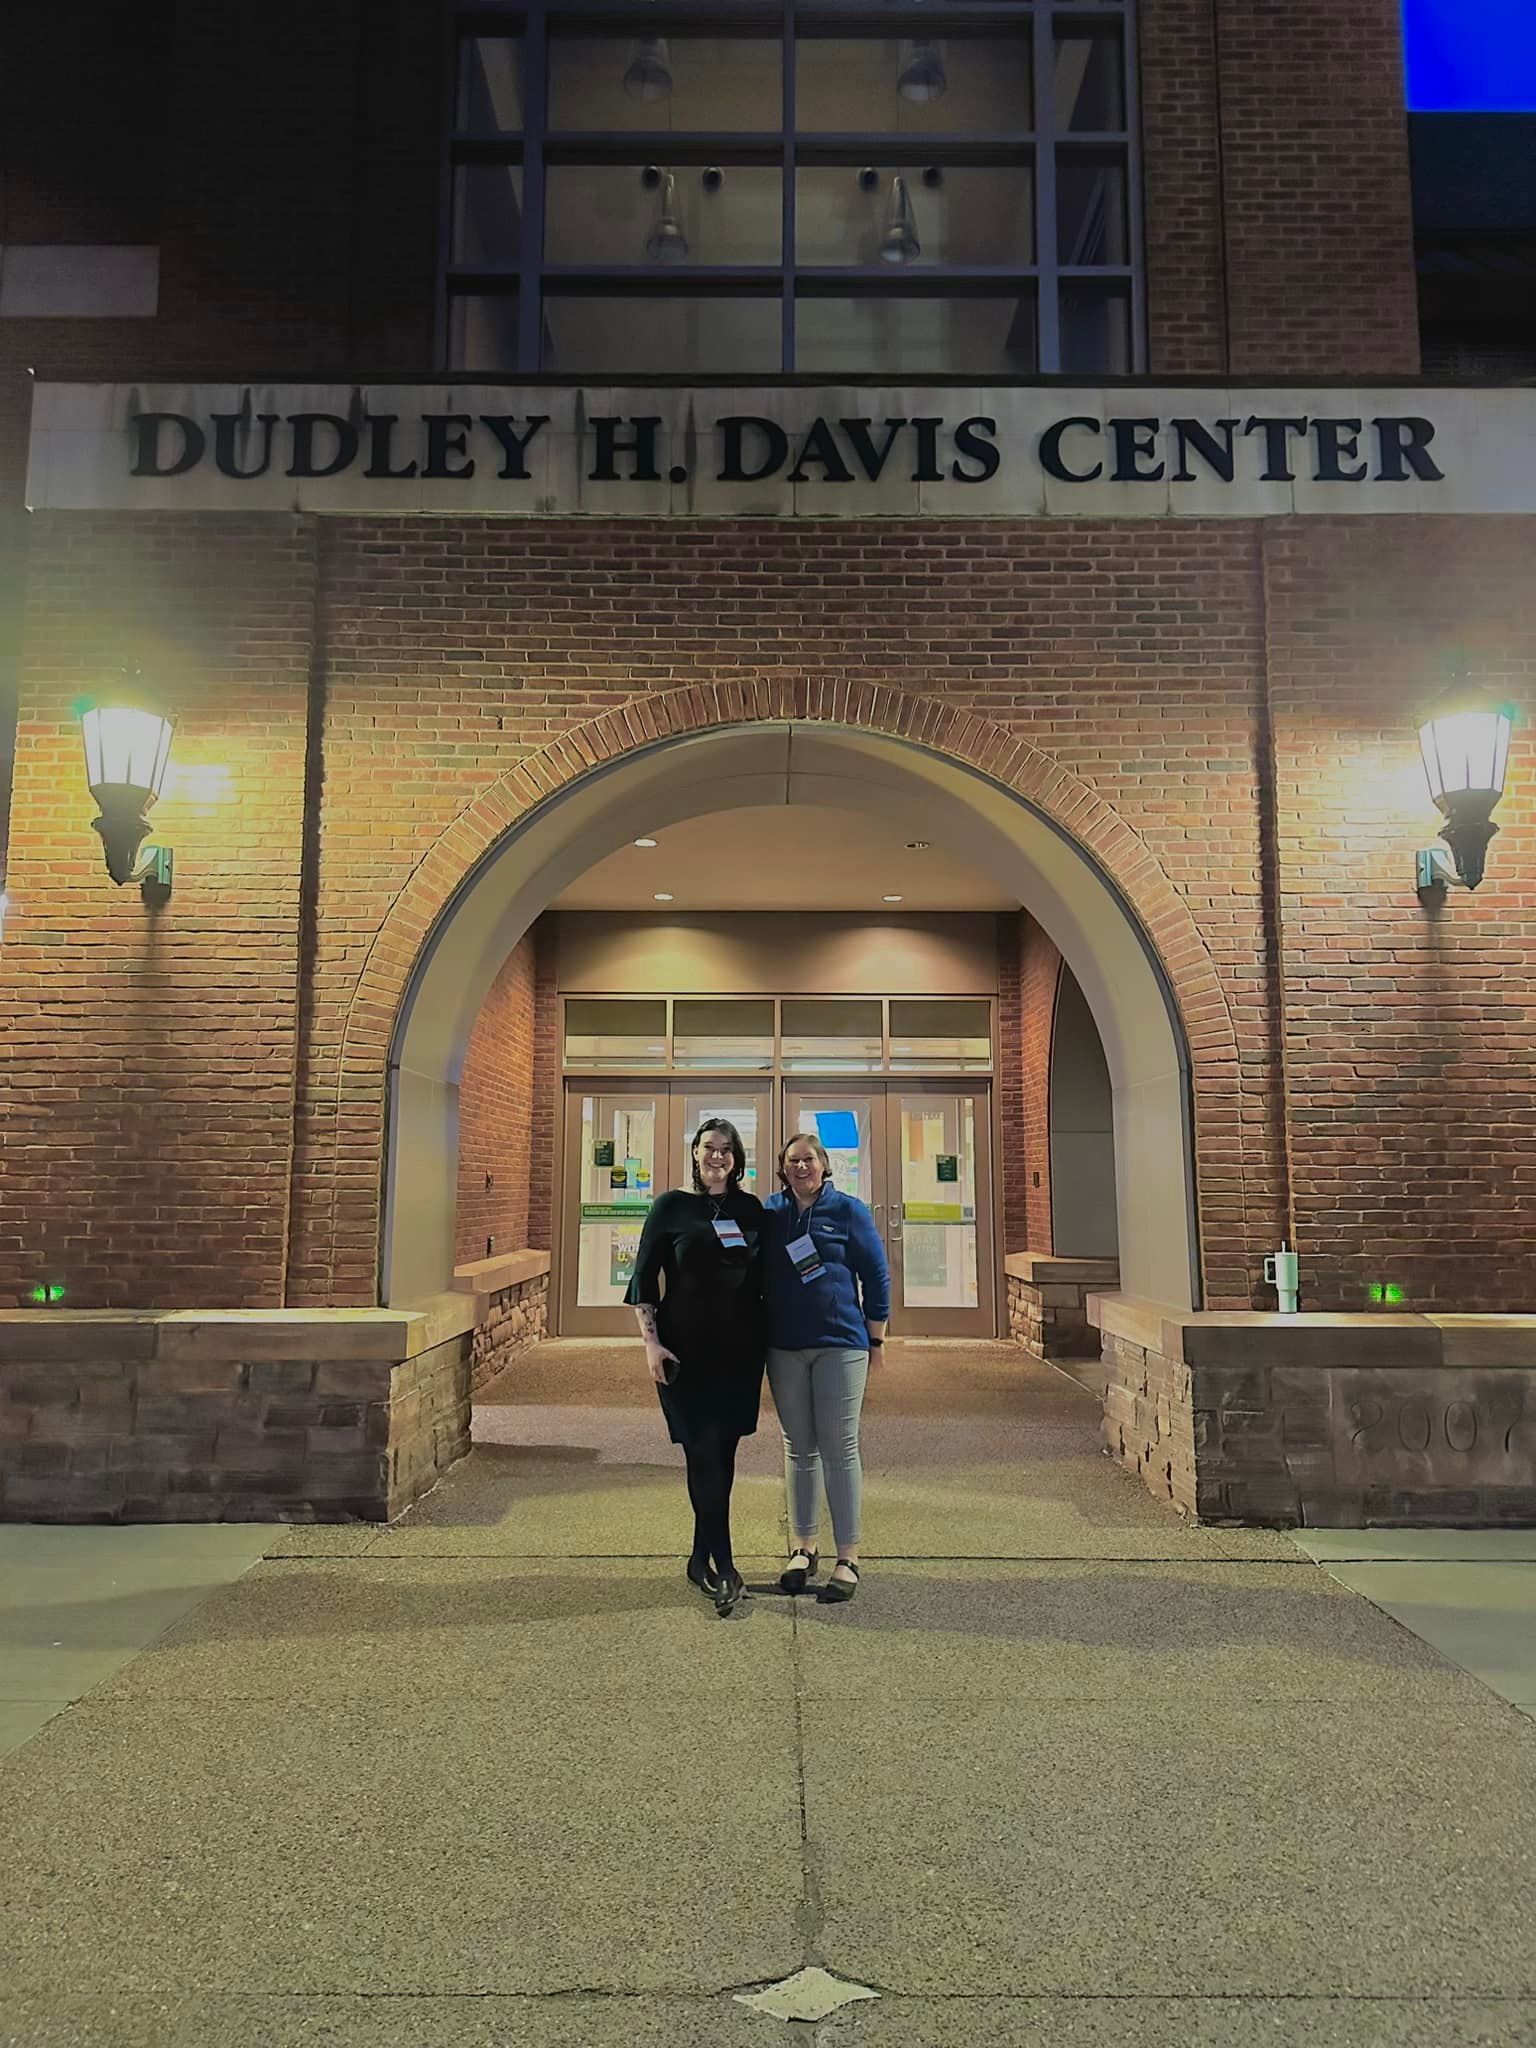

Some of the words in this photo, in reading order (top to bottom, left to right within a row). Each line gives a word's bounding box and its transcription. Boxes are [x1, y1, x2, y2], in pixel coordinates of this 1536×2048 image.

[131, 412, 551, 480] DUDLEY
[588, 414, 688, 484] H.
[715, 416, 1001, 484] DAVIS
[1038, 415, 1445, 484] CENTER
